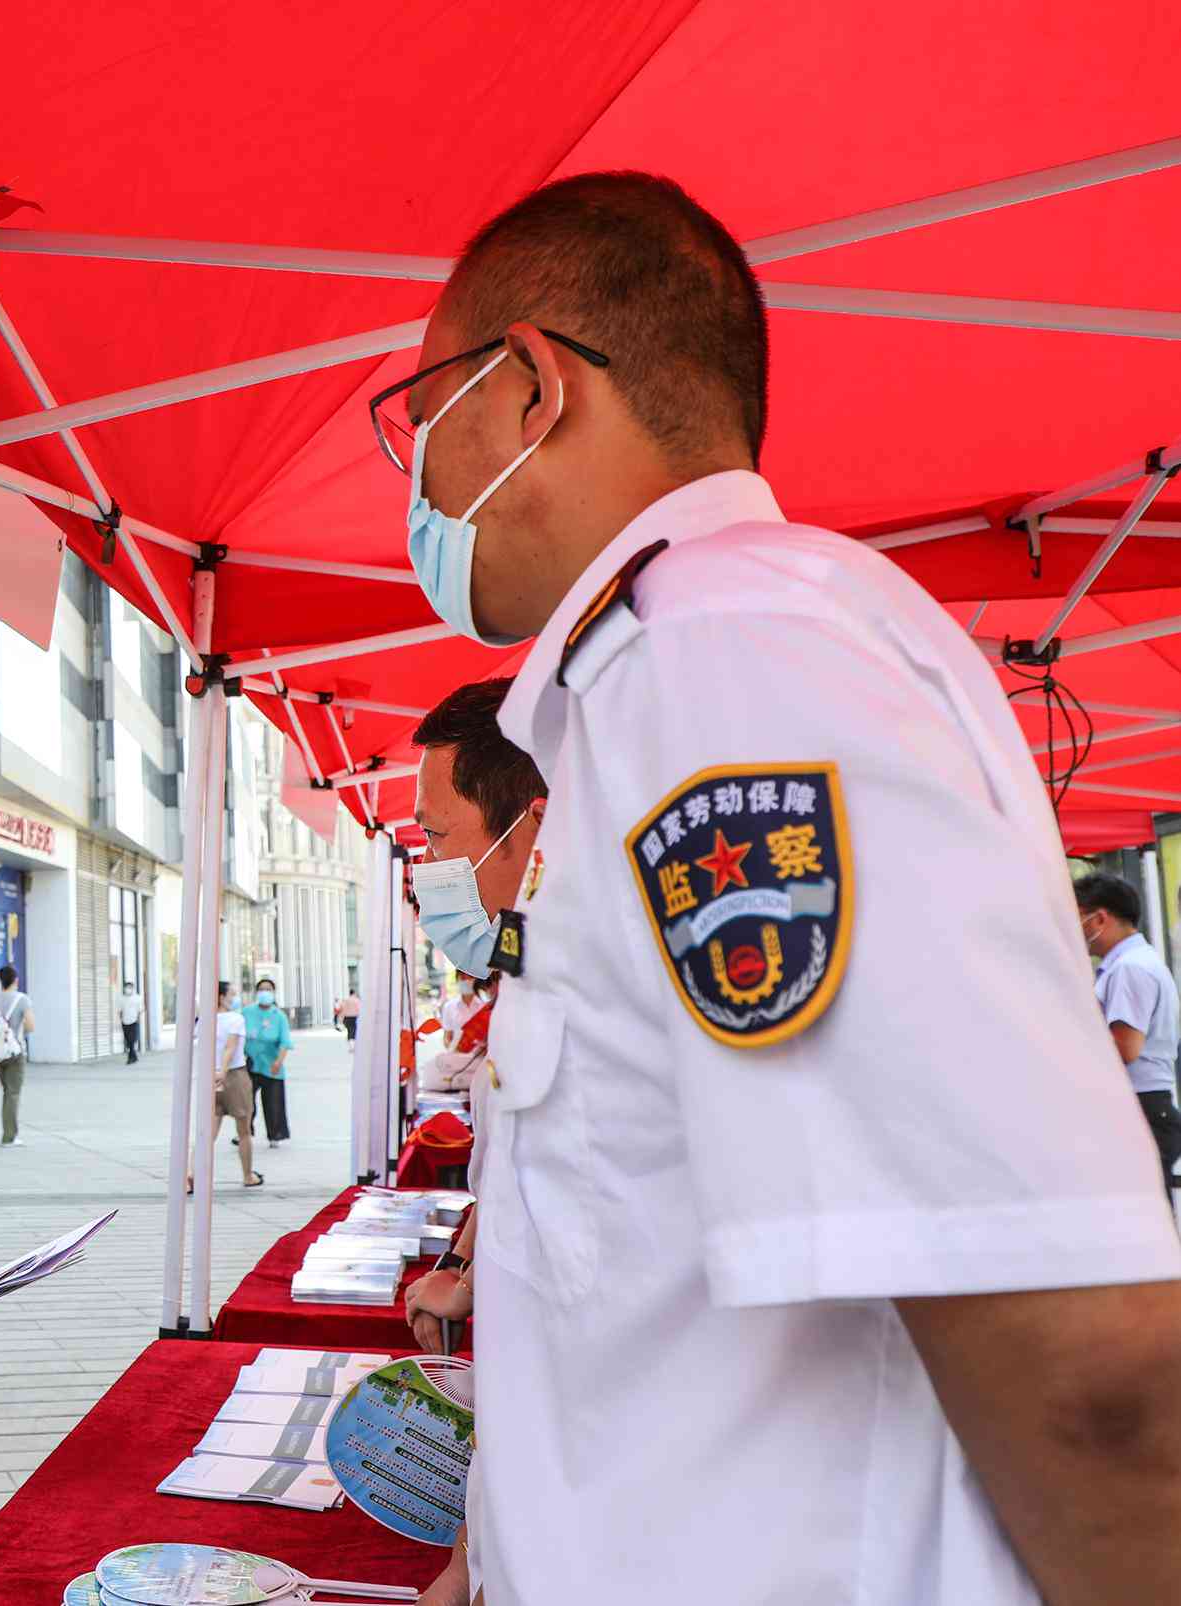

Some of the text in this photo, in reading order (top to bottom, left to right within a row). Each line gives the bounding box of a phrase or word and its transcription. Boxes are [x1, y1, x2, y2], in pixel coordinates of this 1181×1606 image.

[641, 781, 816, 868] 国家劳动保障
